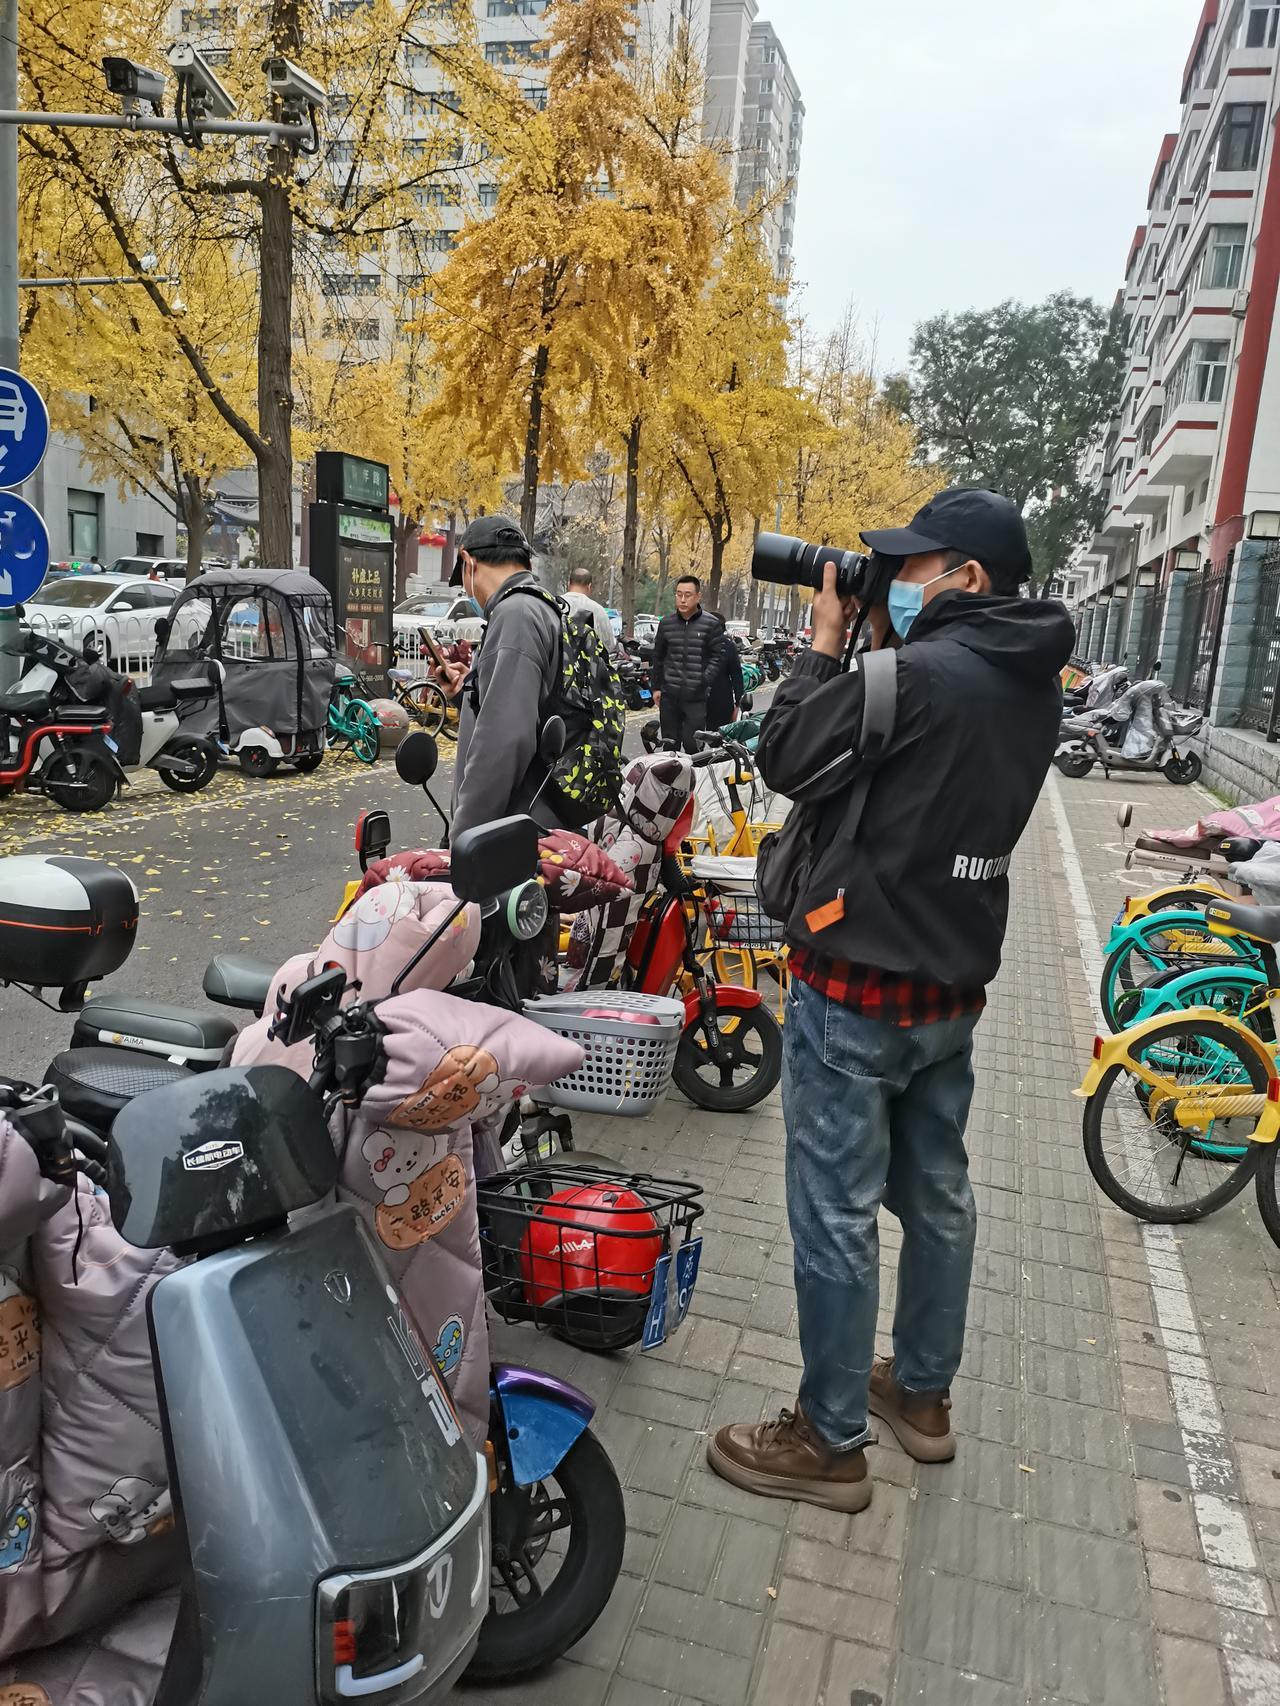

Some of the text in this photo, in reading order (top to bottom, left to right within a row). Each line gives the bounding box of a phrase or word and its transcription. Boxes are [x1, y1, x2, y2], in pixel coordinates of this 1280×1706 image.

[123, 1036, 145, 1046] AIMA
[390, 1168, 461, 1226] 一路平安
